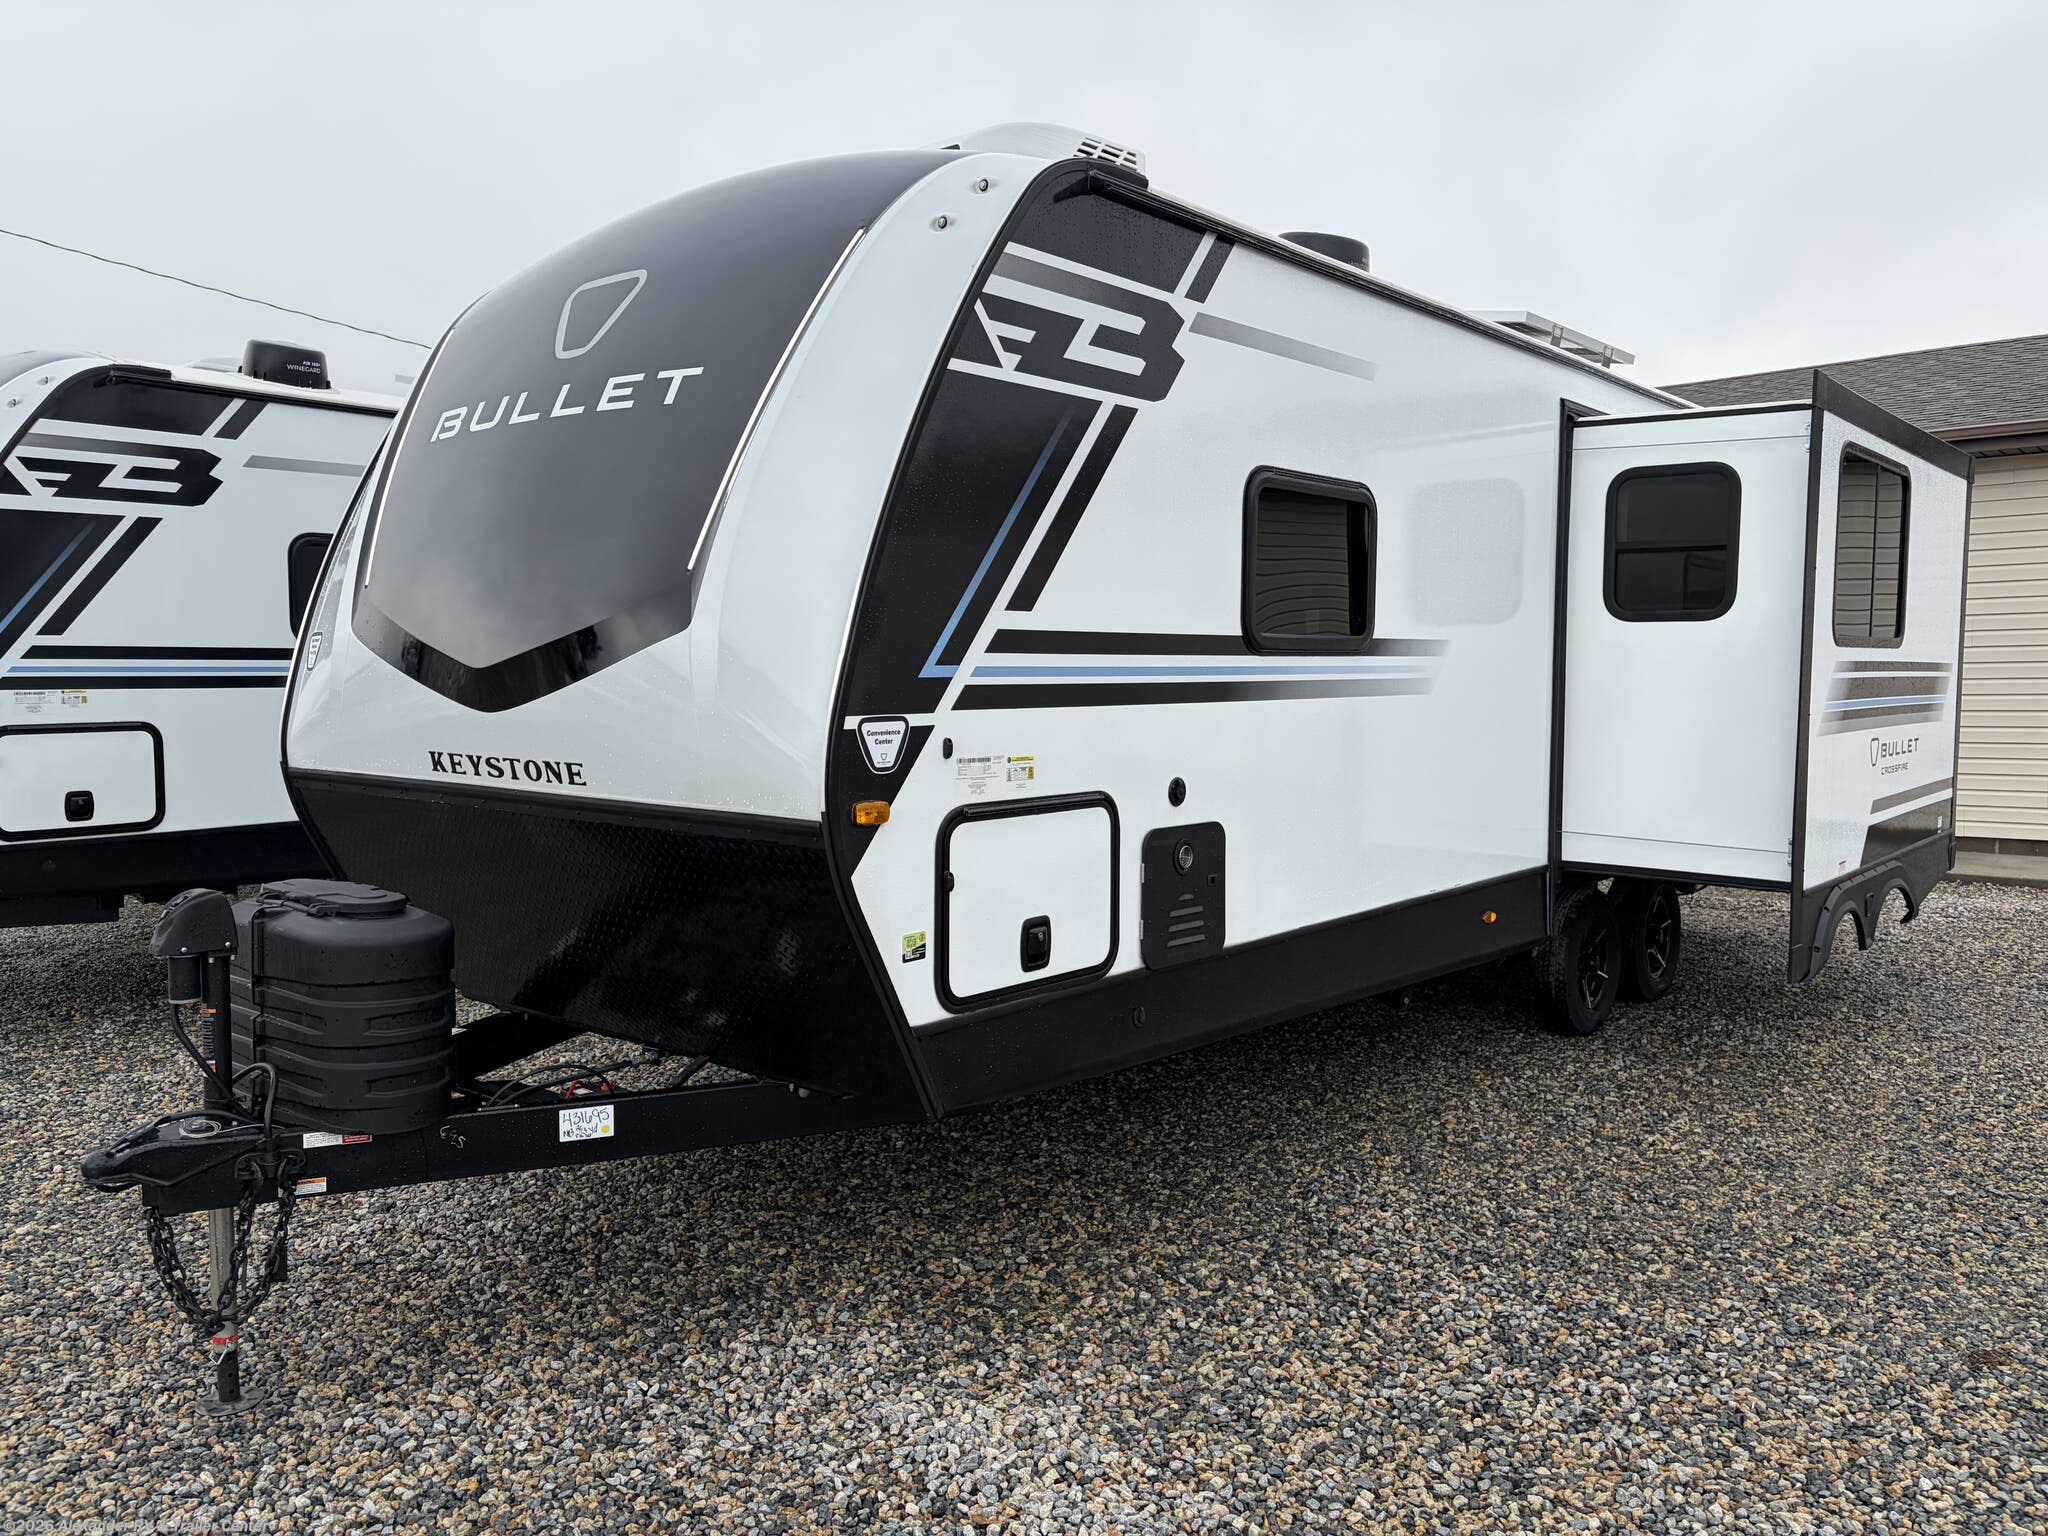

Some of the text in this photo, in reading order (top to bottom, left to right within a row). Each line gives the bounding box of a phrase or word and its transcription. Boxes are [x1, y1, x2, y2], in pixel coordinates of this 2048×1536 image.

[286, 363, 320, 374] WINEGARD
[430, 366, 704, 442] BULLET
[866, 729, 901, 737] Convenience
[1880, 738, 1919, 758] BULLET
[428, 750, 587, 786] KEYSTONE
[1881, 762, 1908, 775] CROSSFIRE
[563, 1107, 610, 1127] 431695
